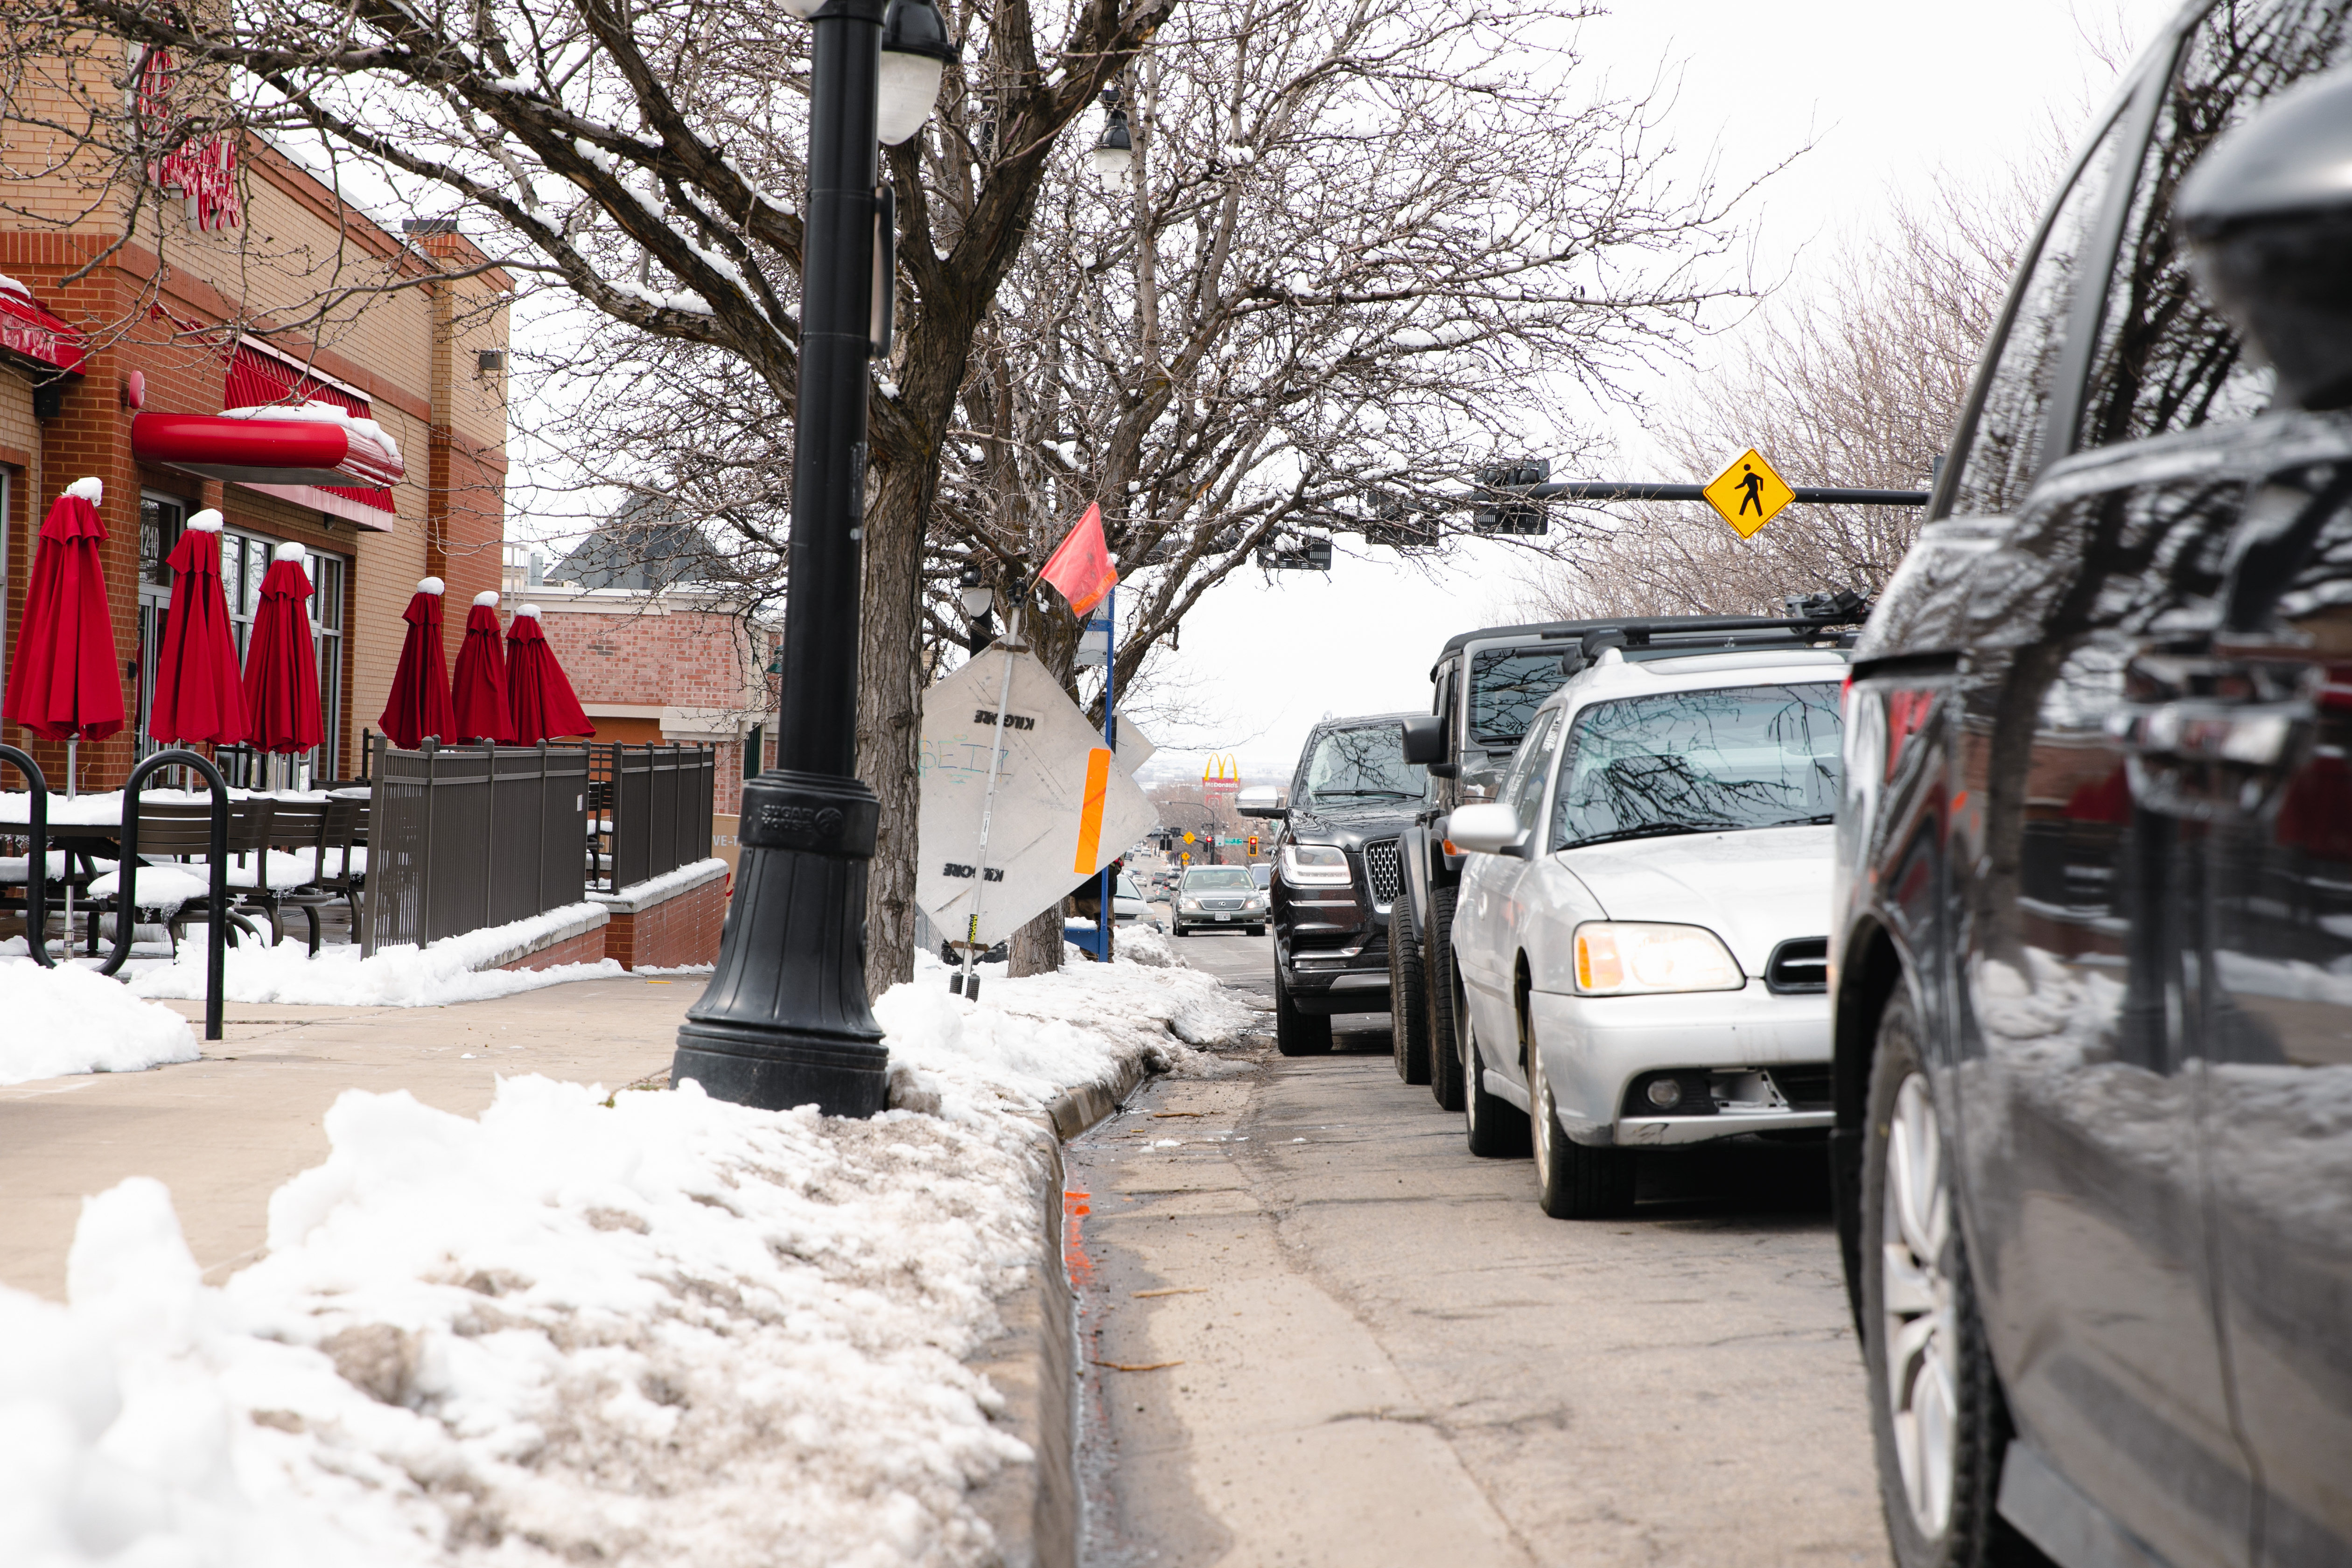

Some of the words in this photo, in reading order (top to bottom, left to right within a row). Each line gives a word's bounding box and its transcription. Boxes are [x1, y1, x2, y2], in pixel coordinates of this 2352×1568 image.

[140, 523, 159, 559] 1210
[974, 710, 1035, 731] KILGORE
[762, 805, 814, 819] SUGAR
[712, 835, 742, 847] VE-T
